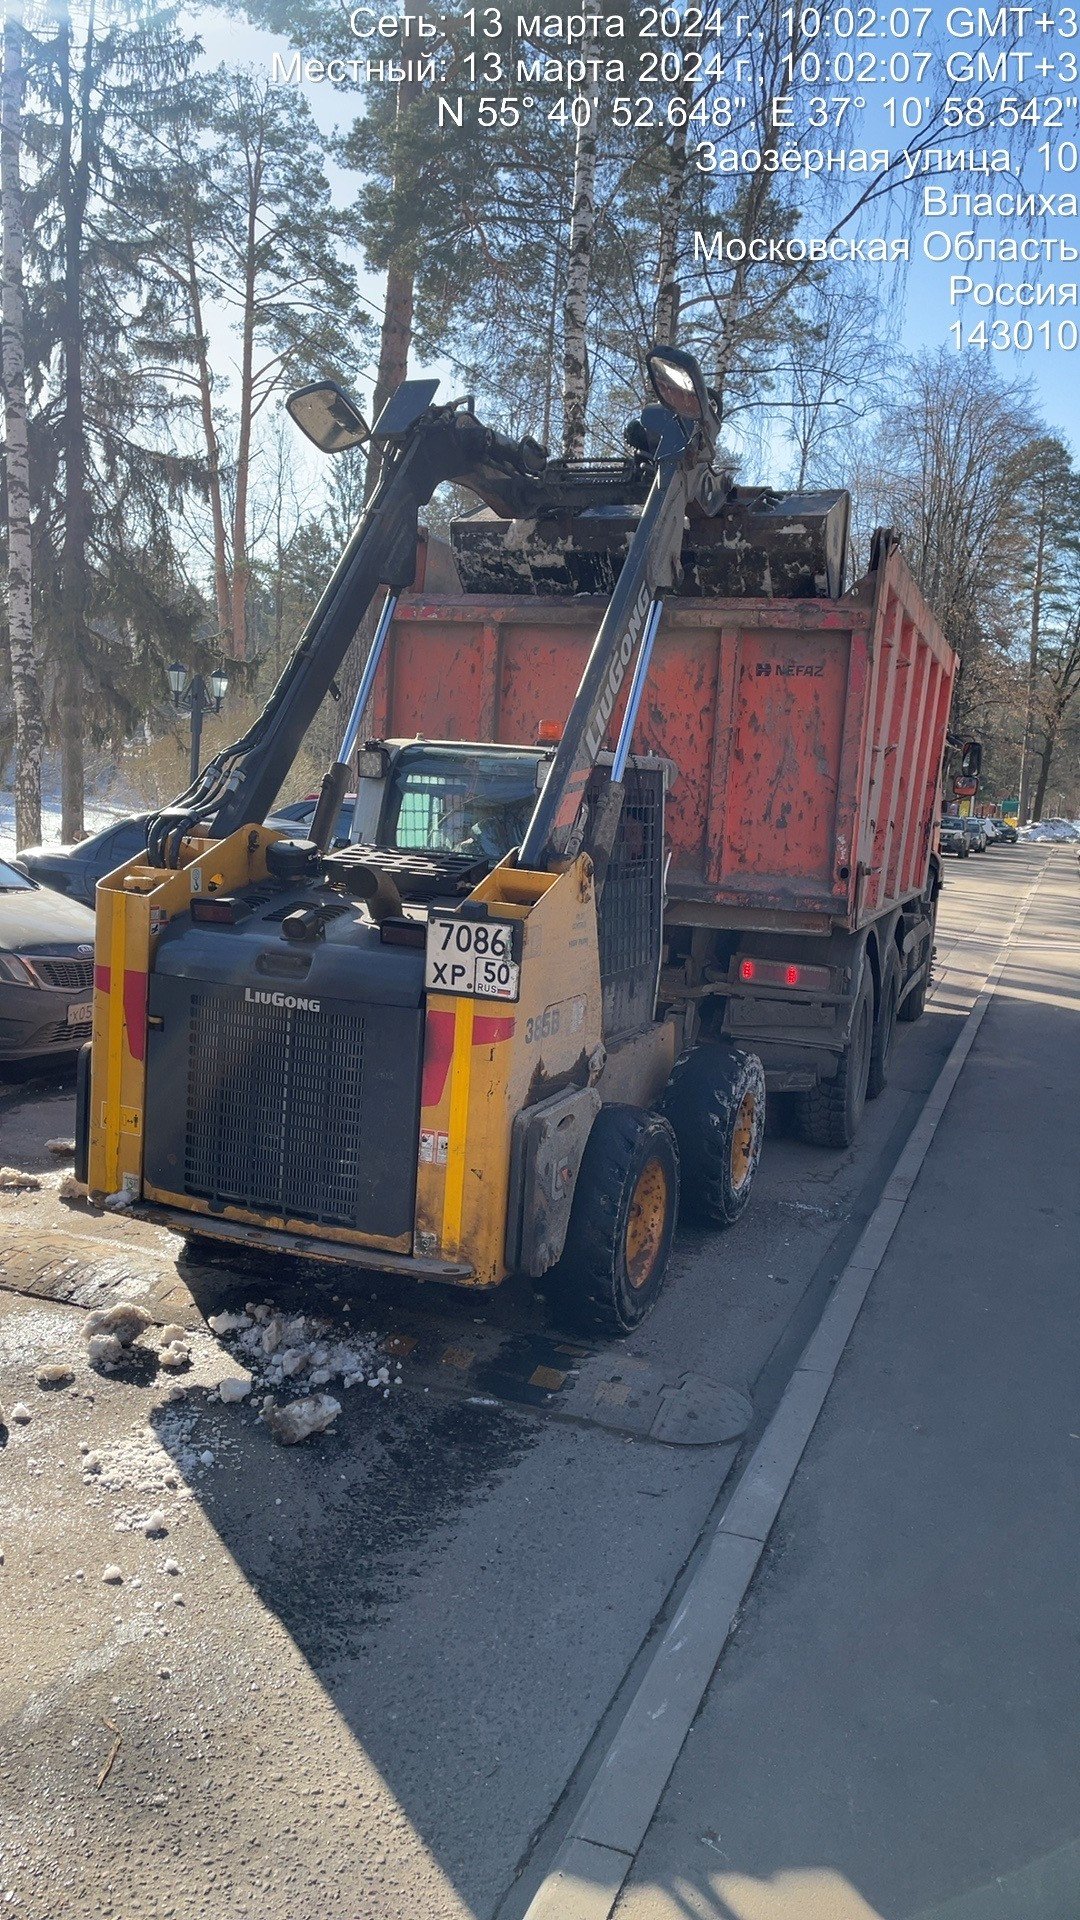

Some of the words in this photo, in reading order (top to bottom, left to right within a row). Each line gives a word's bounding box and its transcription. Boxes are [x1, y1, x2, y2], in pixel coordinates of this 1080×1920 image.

[776, 664, 823, 677] NEFAZ
[439, 922, 506, 956] 7086
[483, 961, 510, 985] 50
[477, 982, 497, 994] RUS
